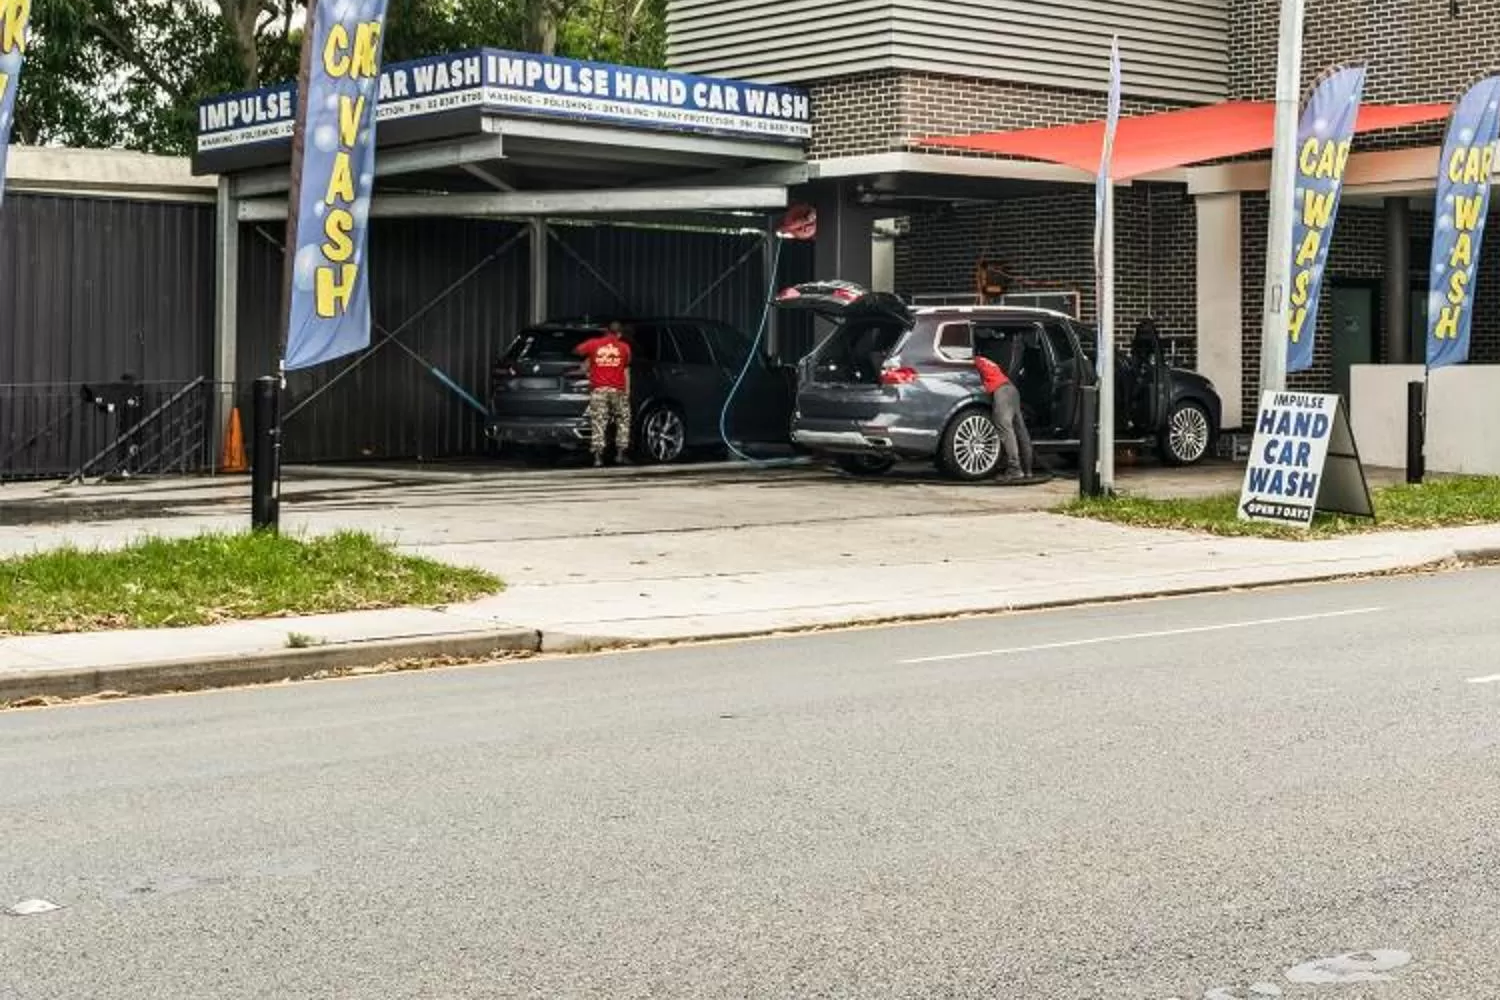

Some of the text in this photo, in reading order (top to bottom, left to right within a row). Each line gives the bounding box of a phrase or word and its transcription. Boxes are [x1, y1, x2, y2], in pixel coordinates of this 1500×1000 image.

[200, 91, 291, 131] IMPULSE
[378, 69, 408, 99] AR
[413, 56, 480, 93] WASH
[487, 55, 809, 120] IMPULSE HAND CAR WASH
[1434, 194, 1483, 340] WASH
[1273, 394, 1325, 409] IMPULSE
[1259, 409, 1329, 439] HAND
[1263, 439, 1311, 468] CAR
[1248, 467, 1318, 499] WASH
[1248, 503, 1275, 516] OPEN
[1283, 507, 1309, 520] DAYS
